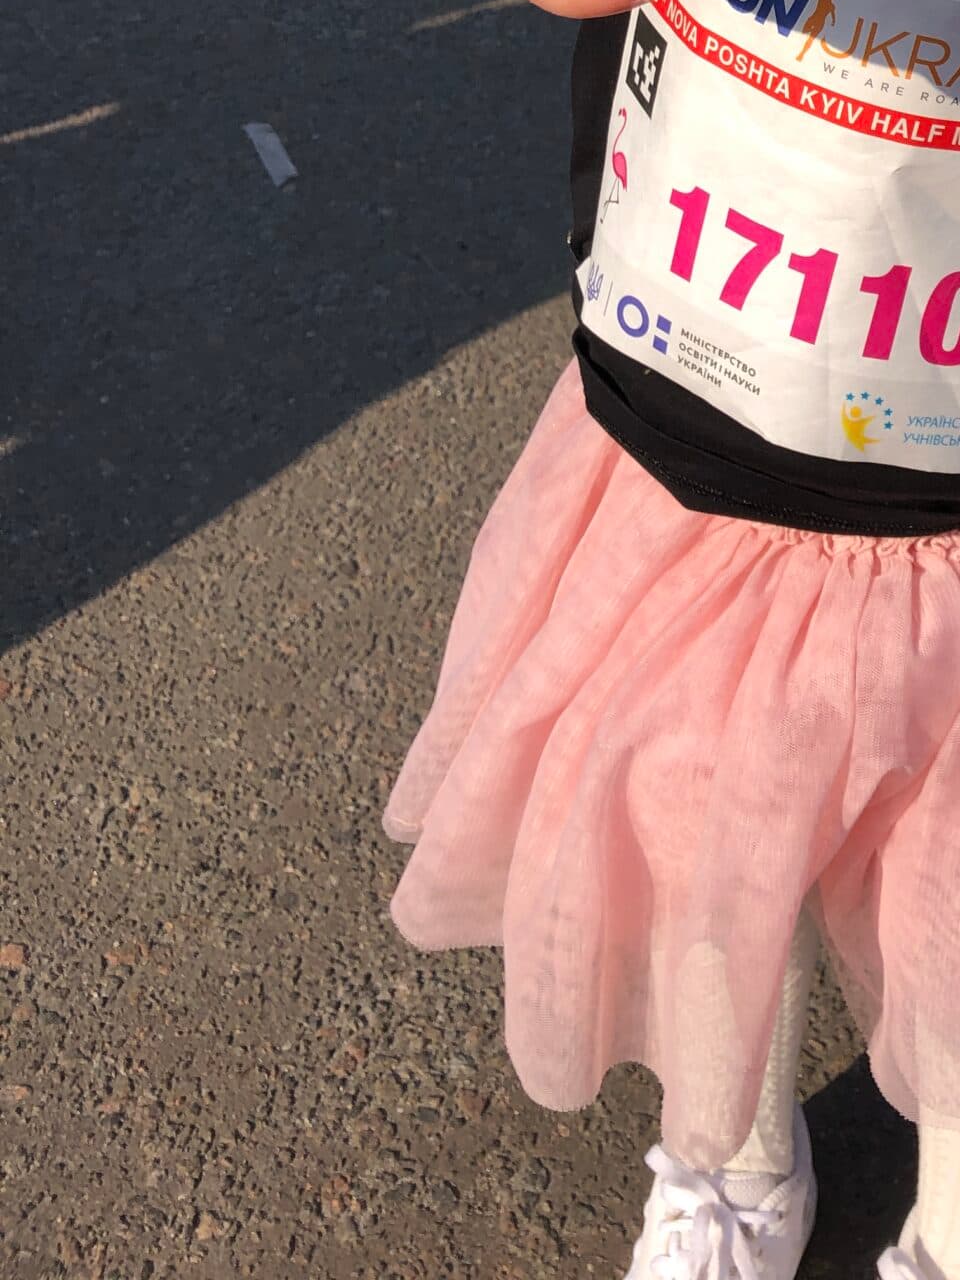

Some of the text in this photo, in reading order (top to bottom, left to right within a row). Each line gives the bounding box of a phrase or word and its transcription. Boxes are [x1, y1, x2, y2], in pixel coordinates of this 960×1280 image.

[666, 1, 698, 48] NOVA
[703, 36, 790, 100] POSHTA
[800, 85, 864, 125] KYIV
[870, 110, 946, 144] HALF
[822, 62, 850, 81] WE
[864, 77, 905, 97] ARE
[677, 355, 722, 388] УКРАЇНИ
[678, 341, 718, 368] ОСВІТИ
[724, 369, 761, 396] НАУКИ
[680, 327, 758, 378] МІНІСТЕРСТВО
